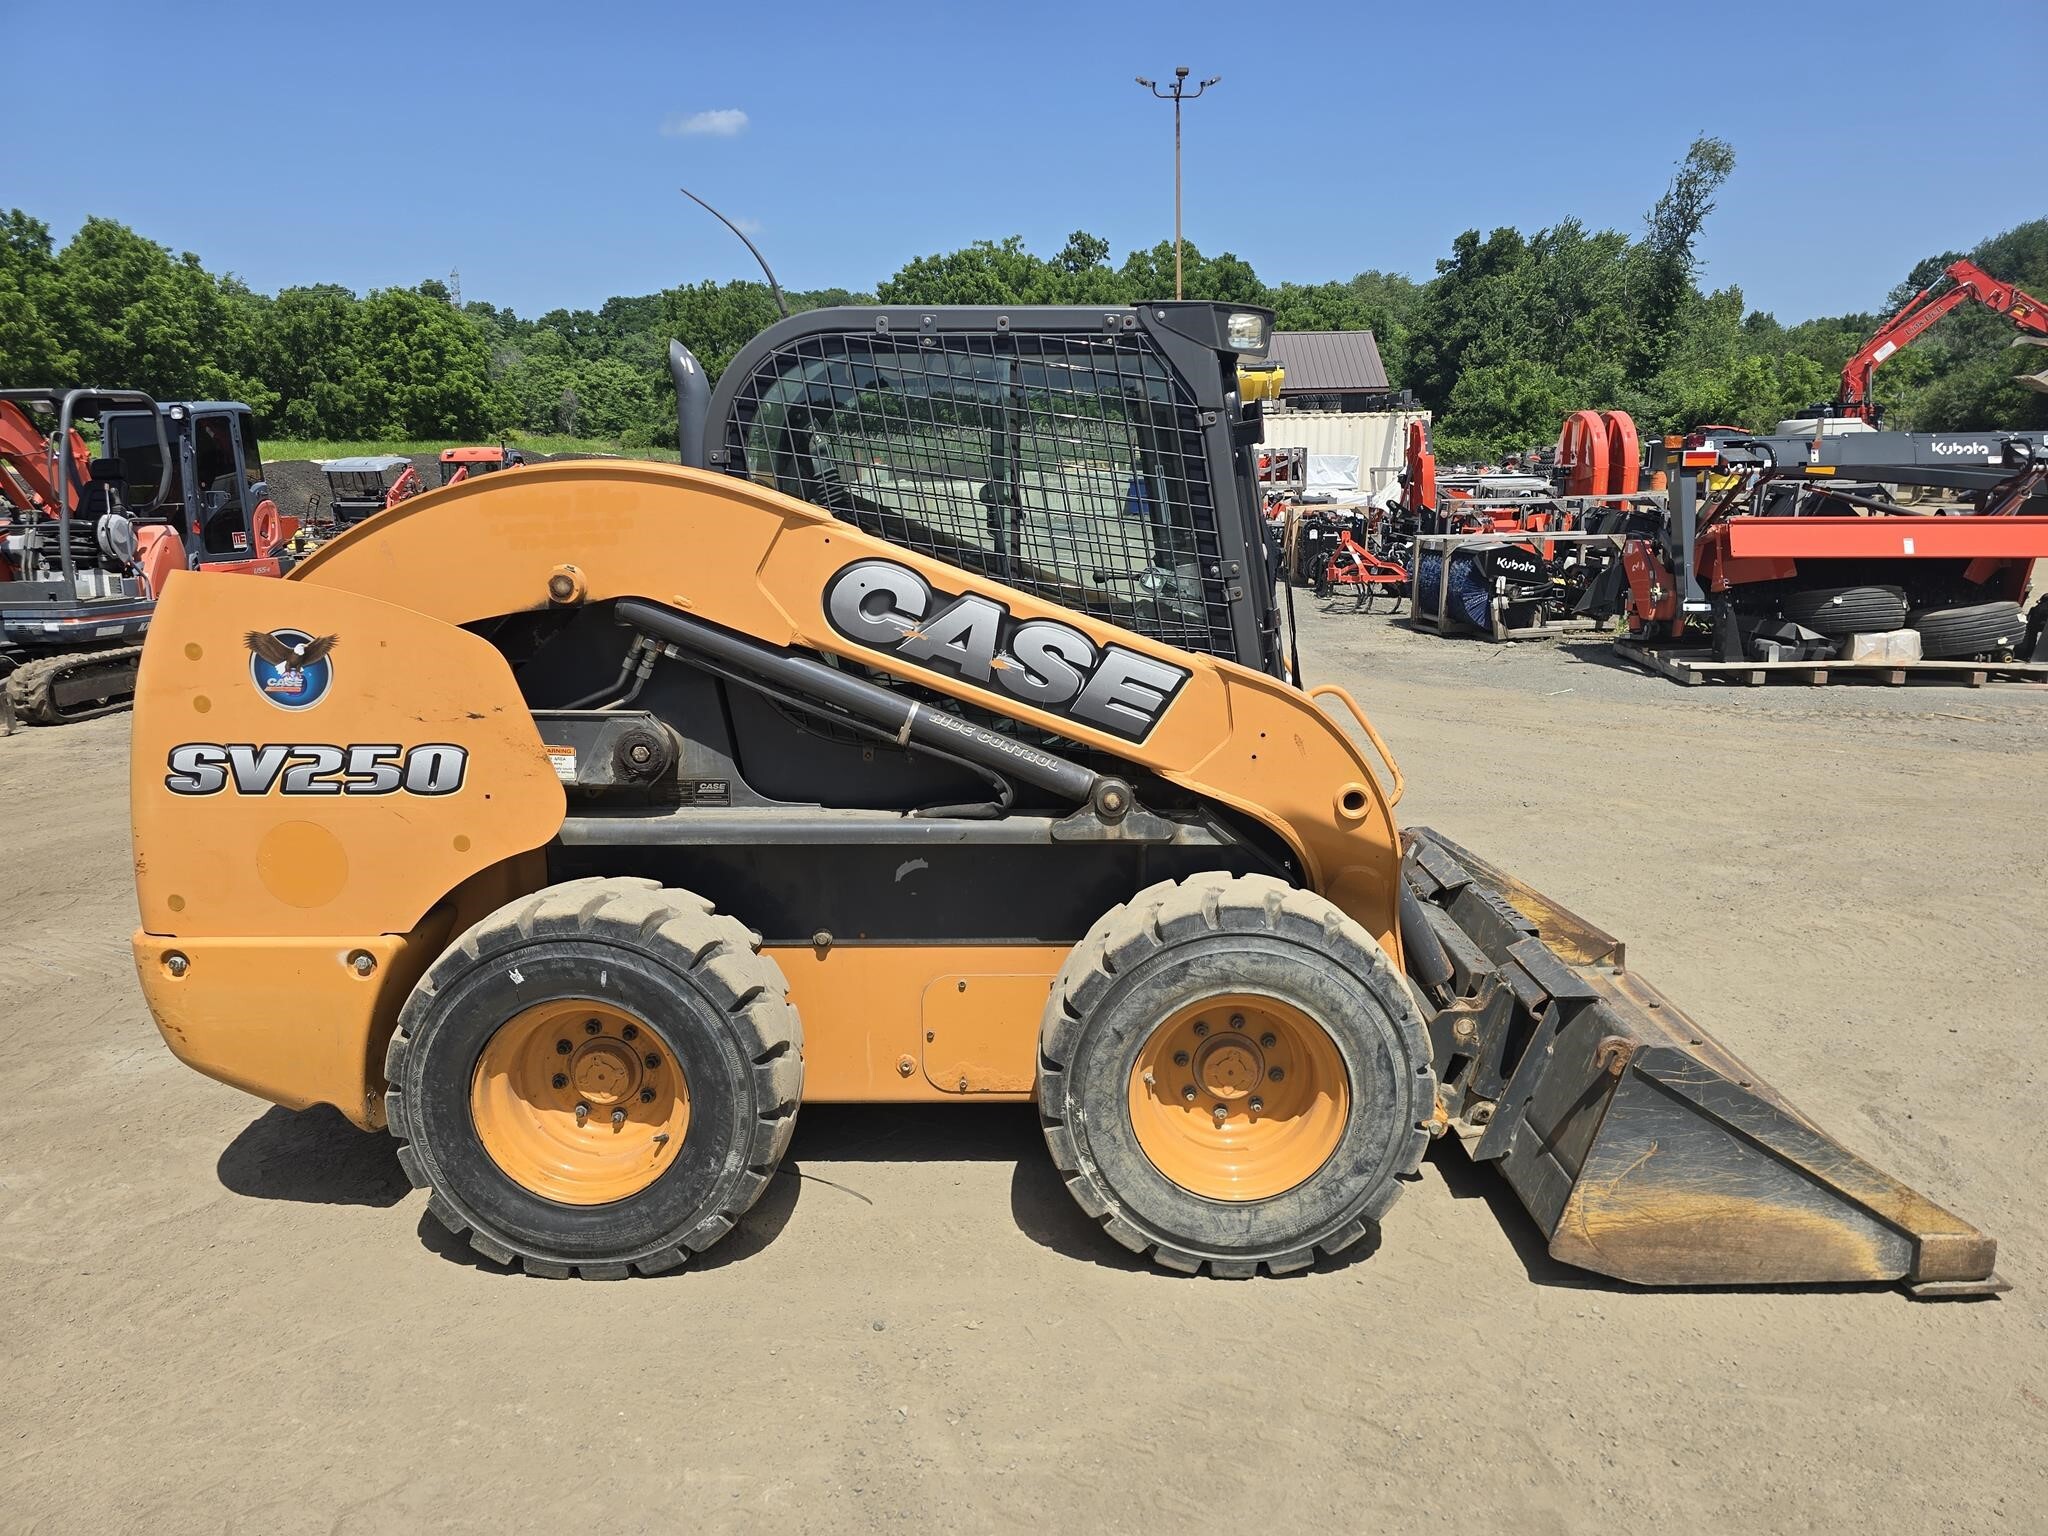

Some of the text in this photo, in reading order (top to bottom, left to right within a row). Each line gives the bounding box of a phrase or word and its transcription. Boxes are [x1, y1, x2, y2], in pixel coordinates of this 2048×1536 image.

[1931, 442, 1989, 455] Kubota
[1496, 556, 1536, 573] Kubota
[824, 561, 1188, 740] CASE
[266, 677, 303, 687] CASE
[928, 711, 1060, 772] RIDE CONTROL
[166, 743, 468, 795] SV250
[699, 782, 726, 790] CASE
